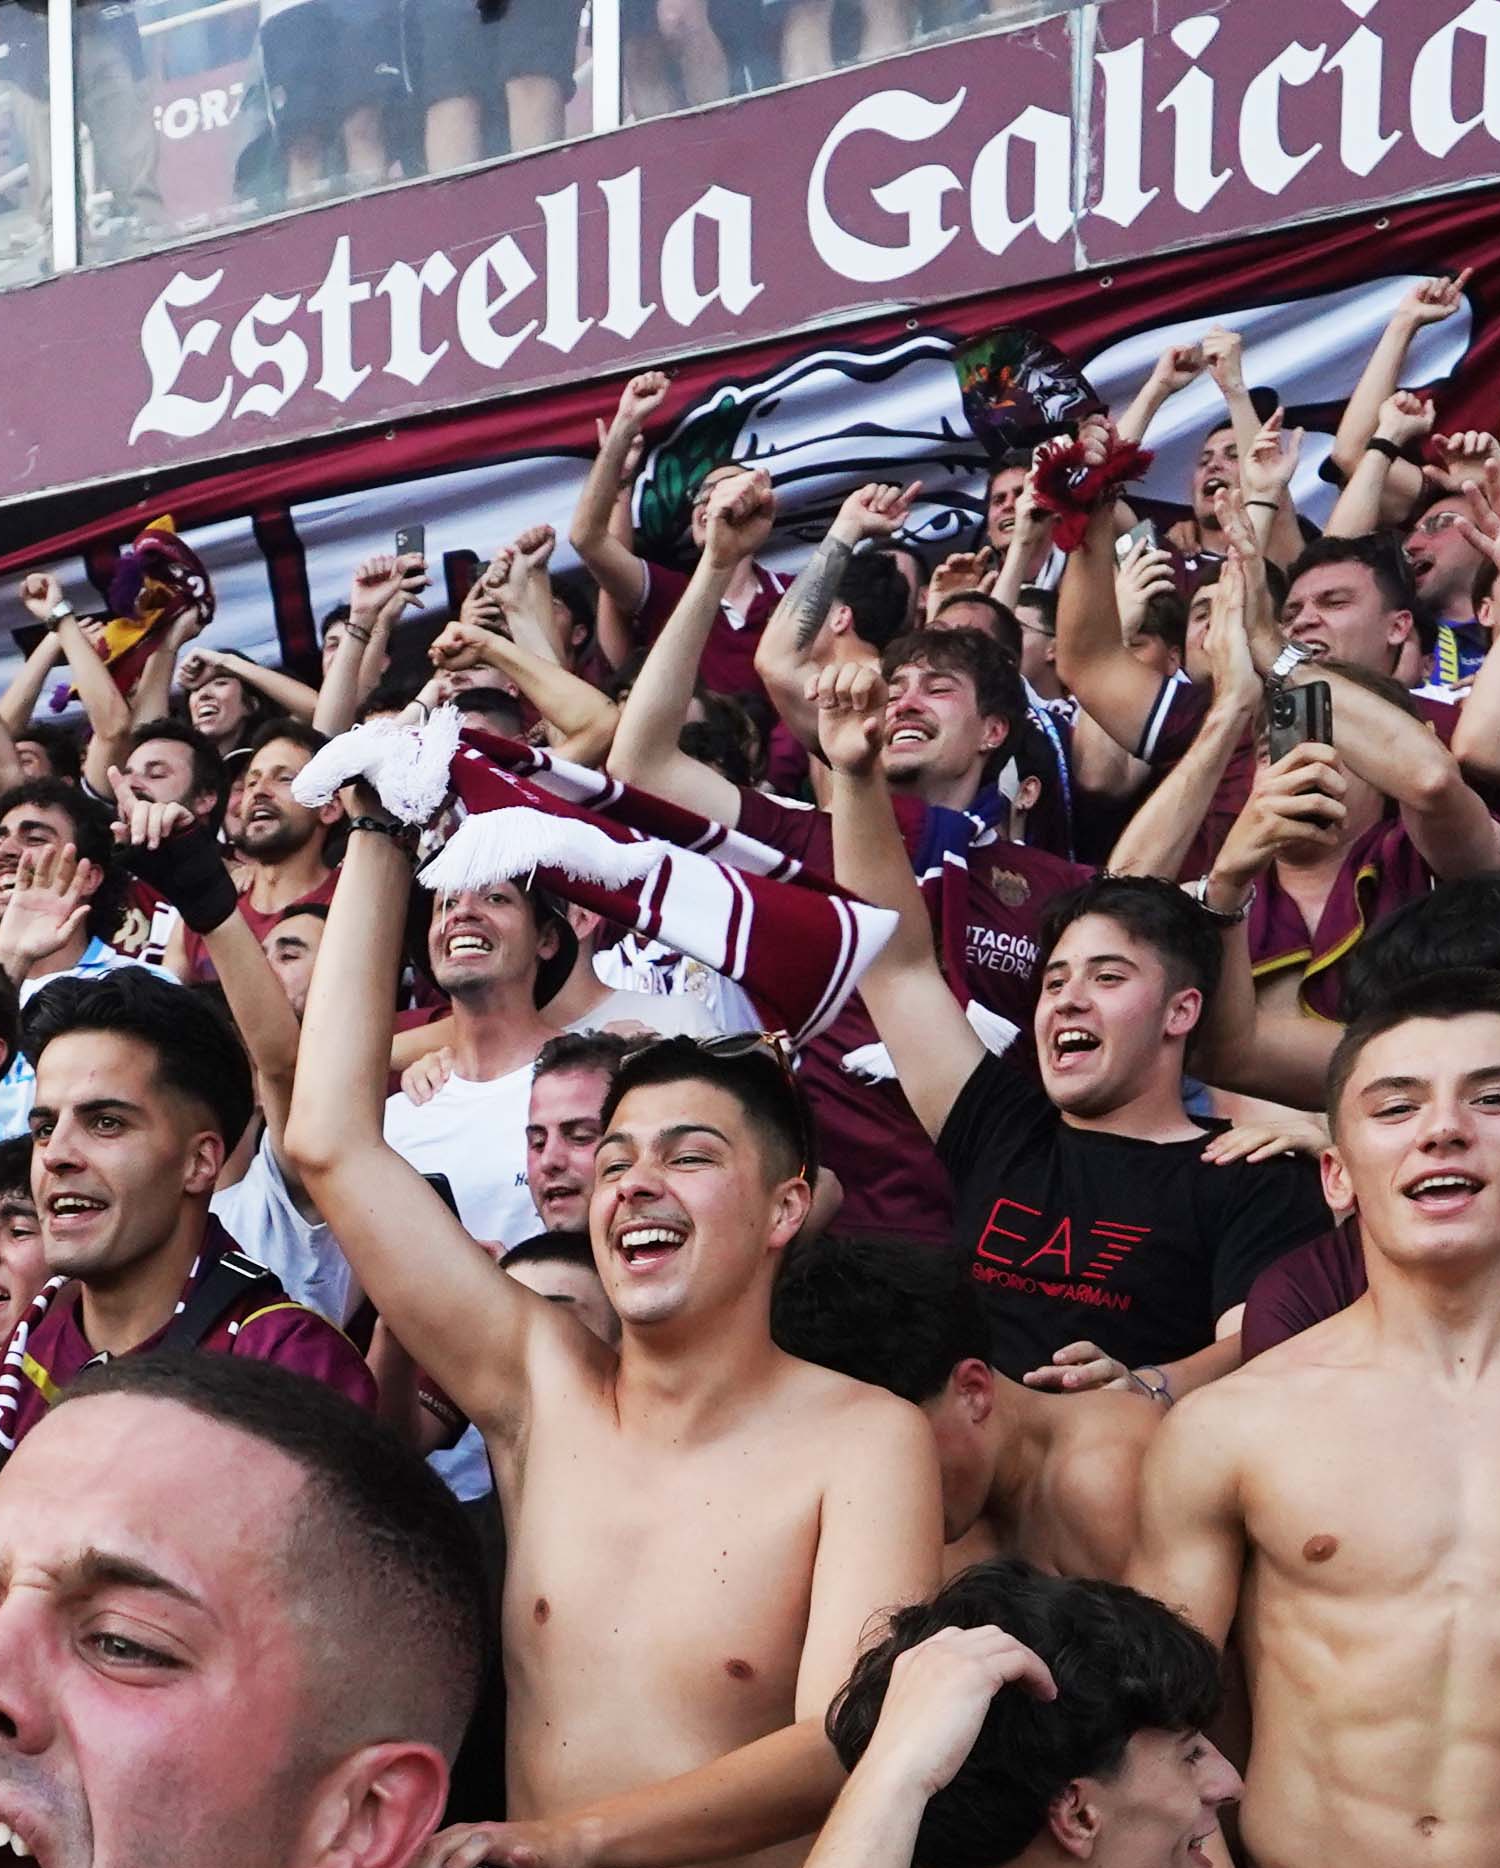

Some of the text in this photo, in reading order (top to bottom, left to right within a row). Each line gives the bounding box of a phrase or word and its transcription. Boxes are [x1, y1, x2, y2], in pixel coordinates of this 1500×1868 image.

[127, 166, 765, 447] Estrella
[971, 1262, 1132, 1314] EMPORIO ARMANI
